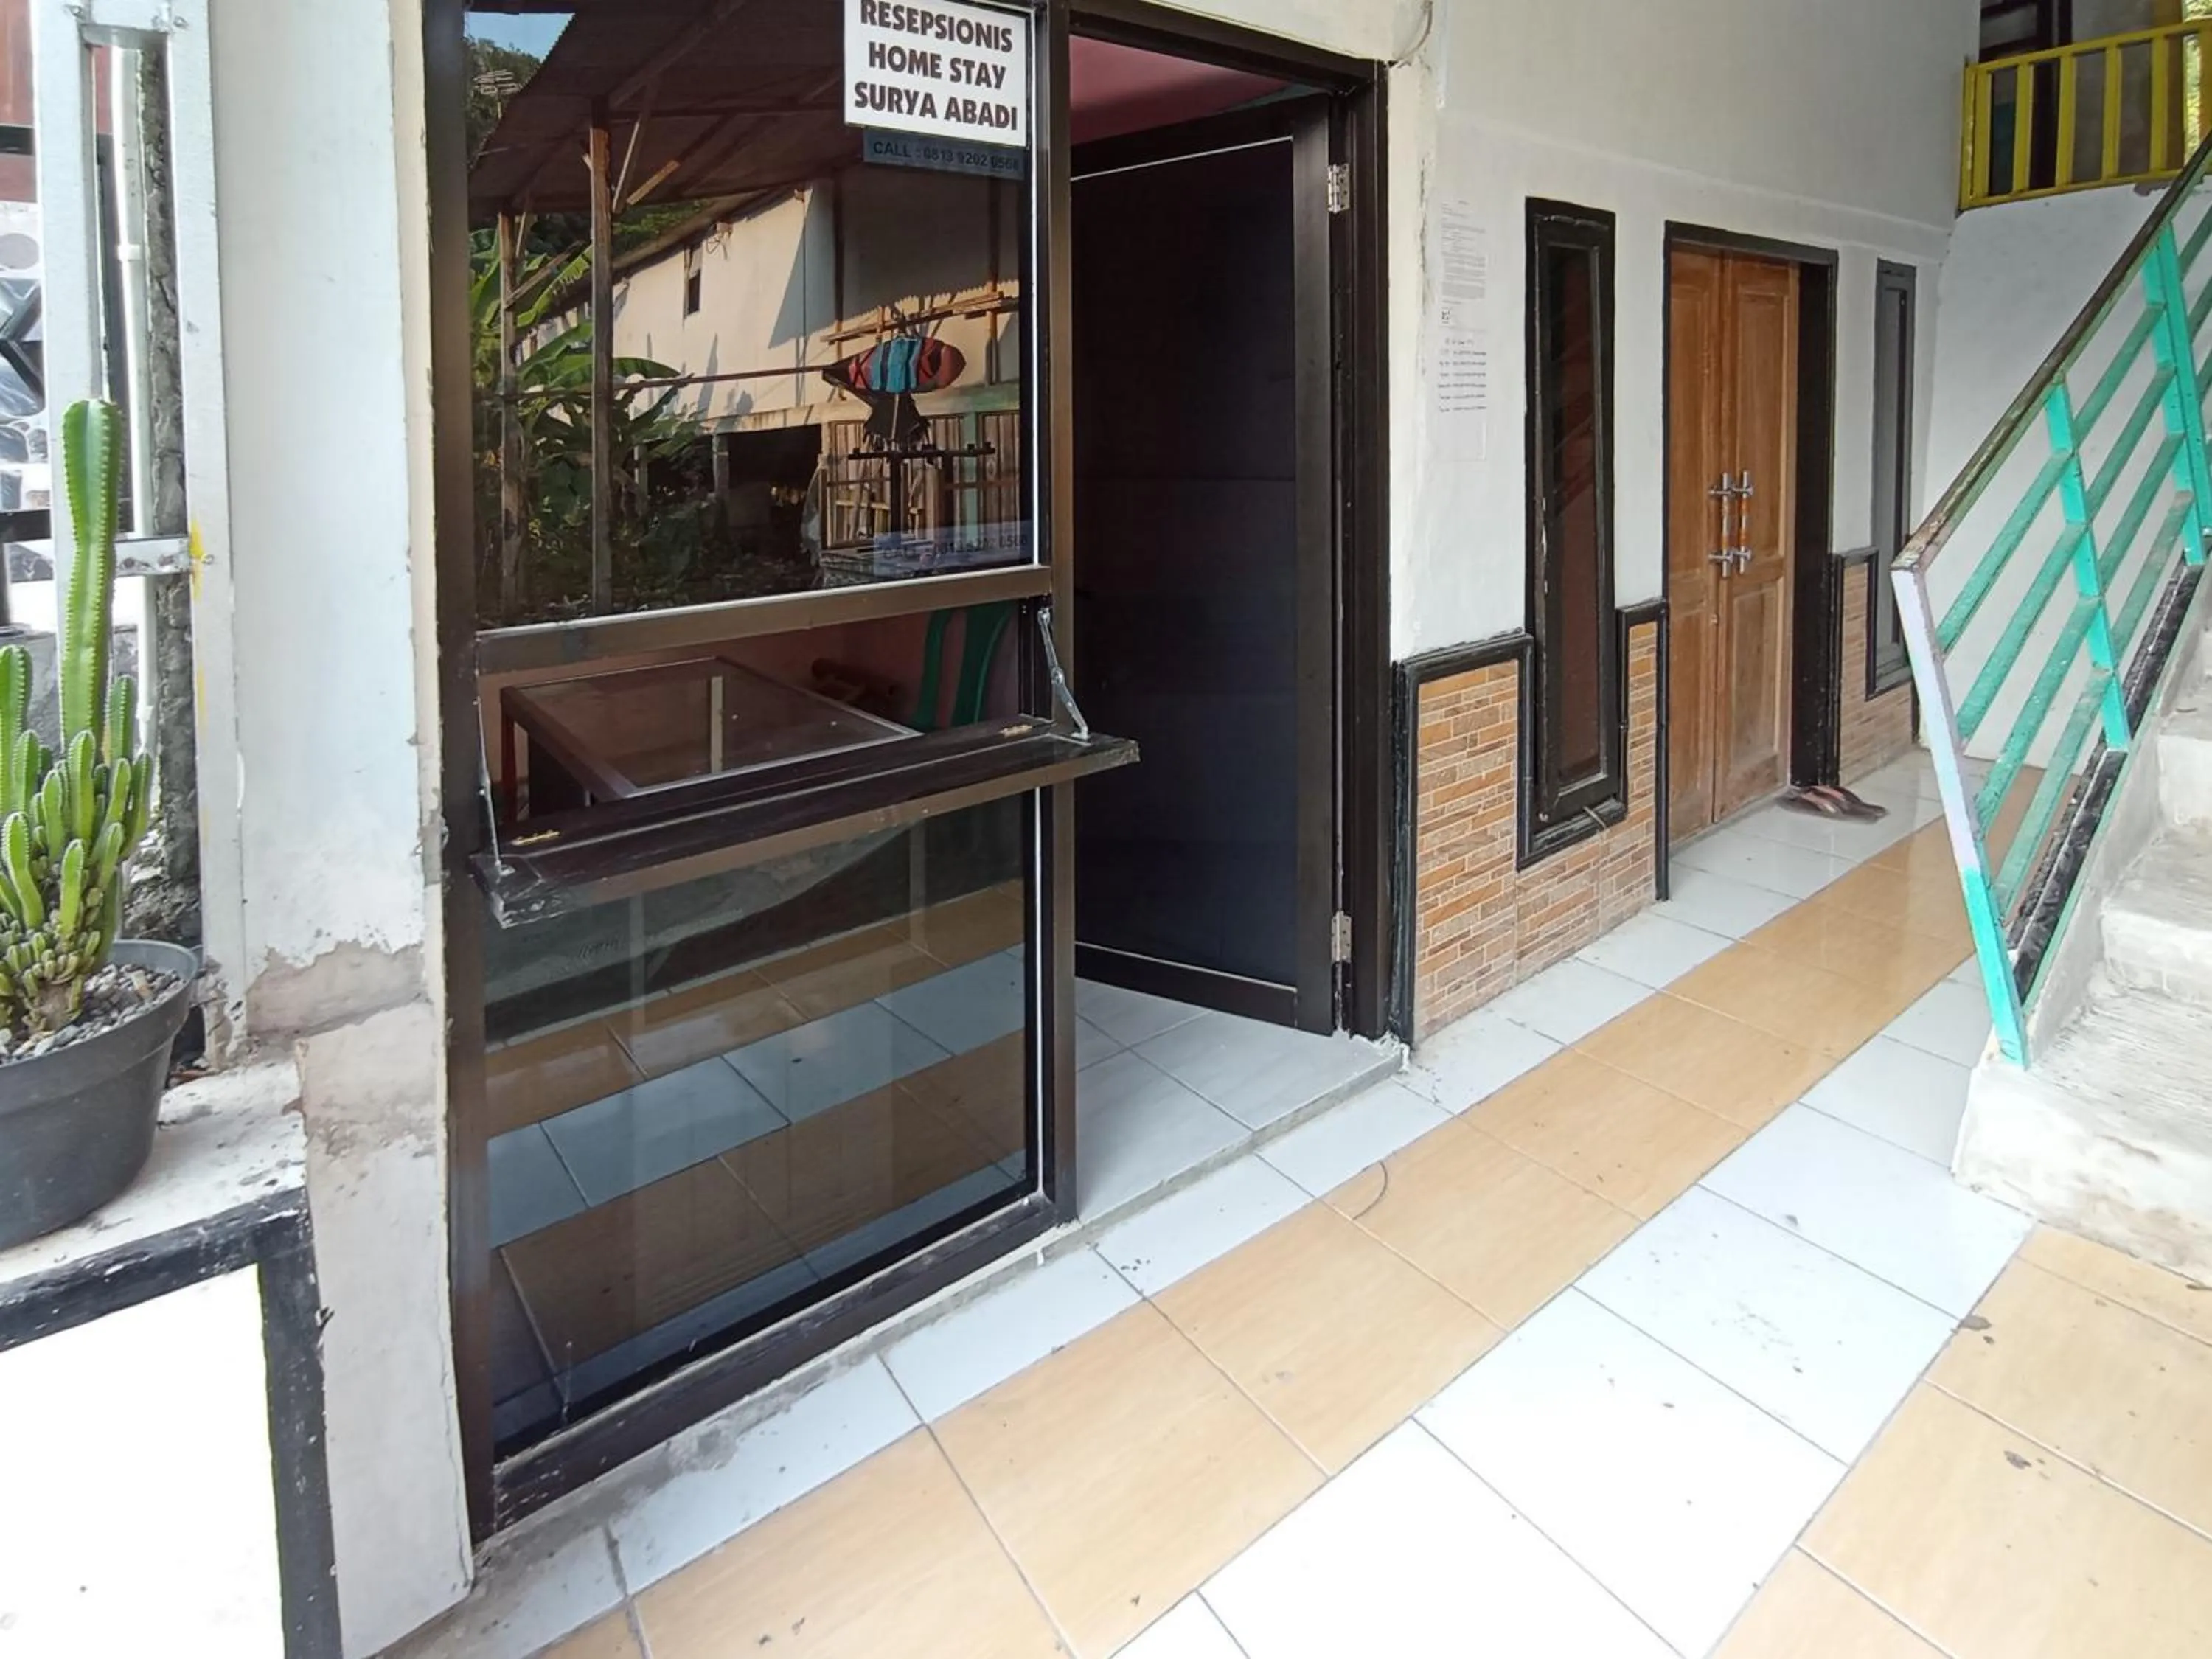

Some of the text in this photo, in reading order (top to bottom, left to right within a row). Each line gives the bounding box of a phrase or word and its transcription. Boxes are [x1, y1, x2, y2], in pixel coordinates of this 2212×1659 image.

[860, 0, 1013, 52] RESEPSIONIS
[869, 41, 1006, 89] HOME STAY
[854, 81, 1018, 130] SURYA ABADI
[873, 140, 911, 158] CALL
